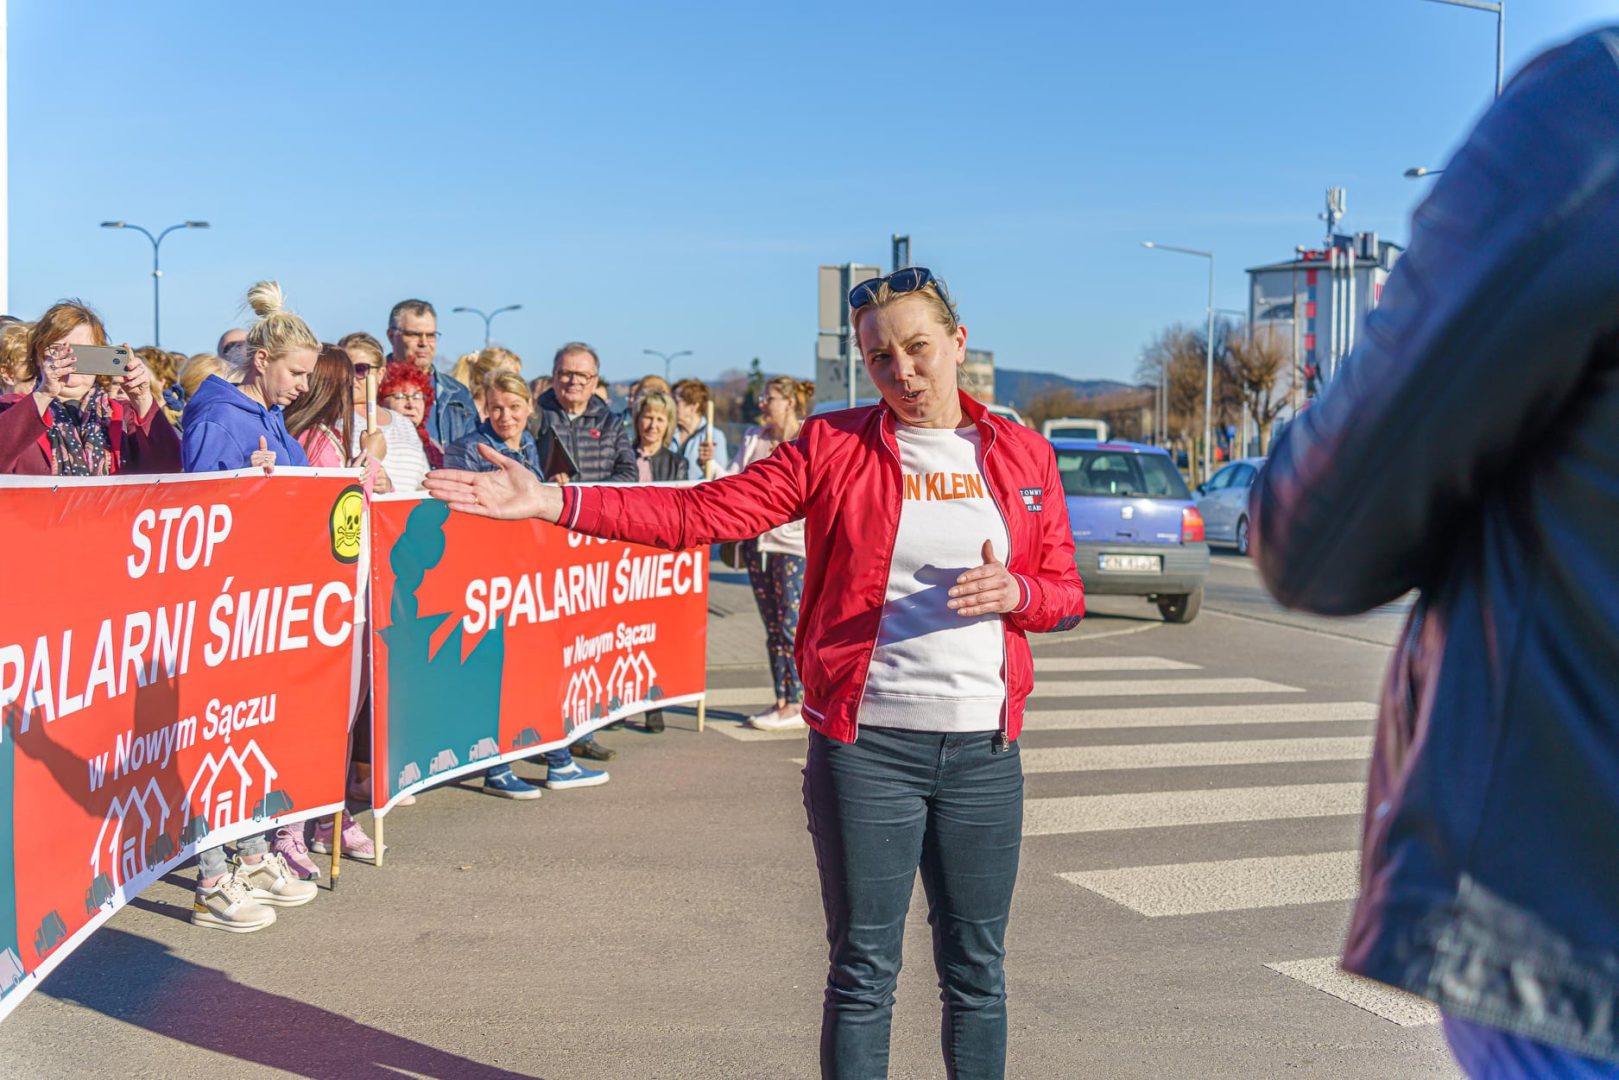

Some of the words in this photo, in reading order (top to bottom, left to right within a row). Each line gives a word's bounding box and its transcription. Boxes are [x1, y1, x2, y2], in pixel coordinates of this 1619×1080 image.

[926, 472, 984, 501] KLEIN
[127, 504, 233, 579] STOP
[463, 561, 609, 634] SPALARNI
[613, 547, 703, 605] ŚMIECI
[0, 600, 197, 744] PALARNI
[203, 576, 354, 667] ŚMIEC
[563, 645, 574, 668] w
[573, 634, 614, 663] Nowym
[615, 622, 656, 653] Sączu
[89, 752, 109, 792] w
[113, 715, 197, 780] Nowym
[202, 694, 277, 744] Sączu
